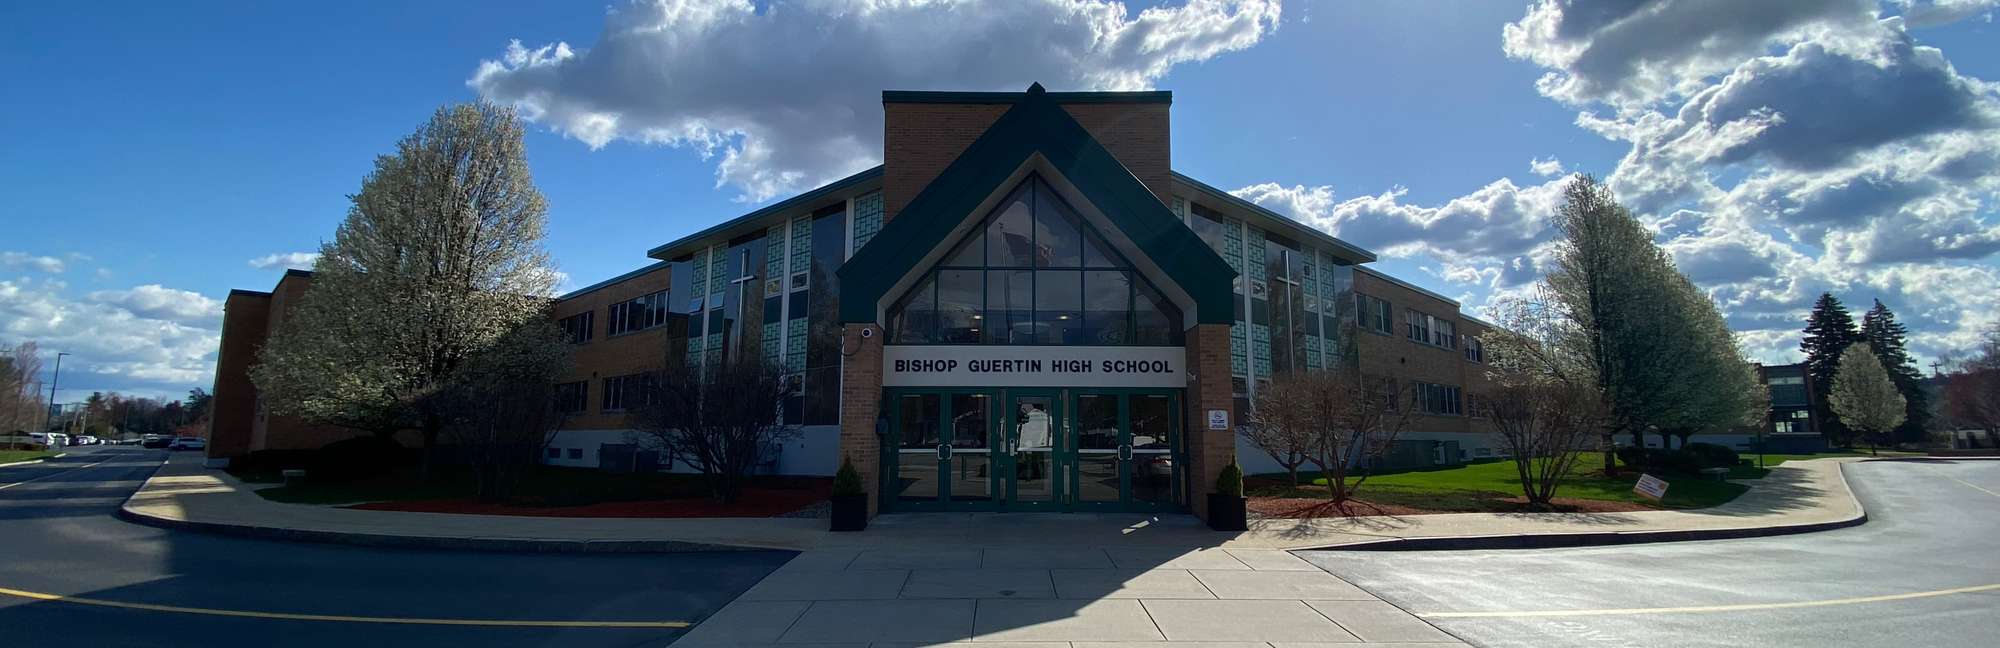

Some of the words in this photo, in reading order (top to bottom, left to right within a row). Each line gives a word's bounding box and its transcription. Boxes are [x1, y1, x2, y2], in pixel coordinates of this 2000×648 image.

[894, 359, 958, 373] BISHOP
[968, 359, 1042, 373] GUERTIN
[1052, 360, 1093, 373] HIGH
[1102, 360, 1174, 374] SCHOOL
